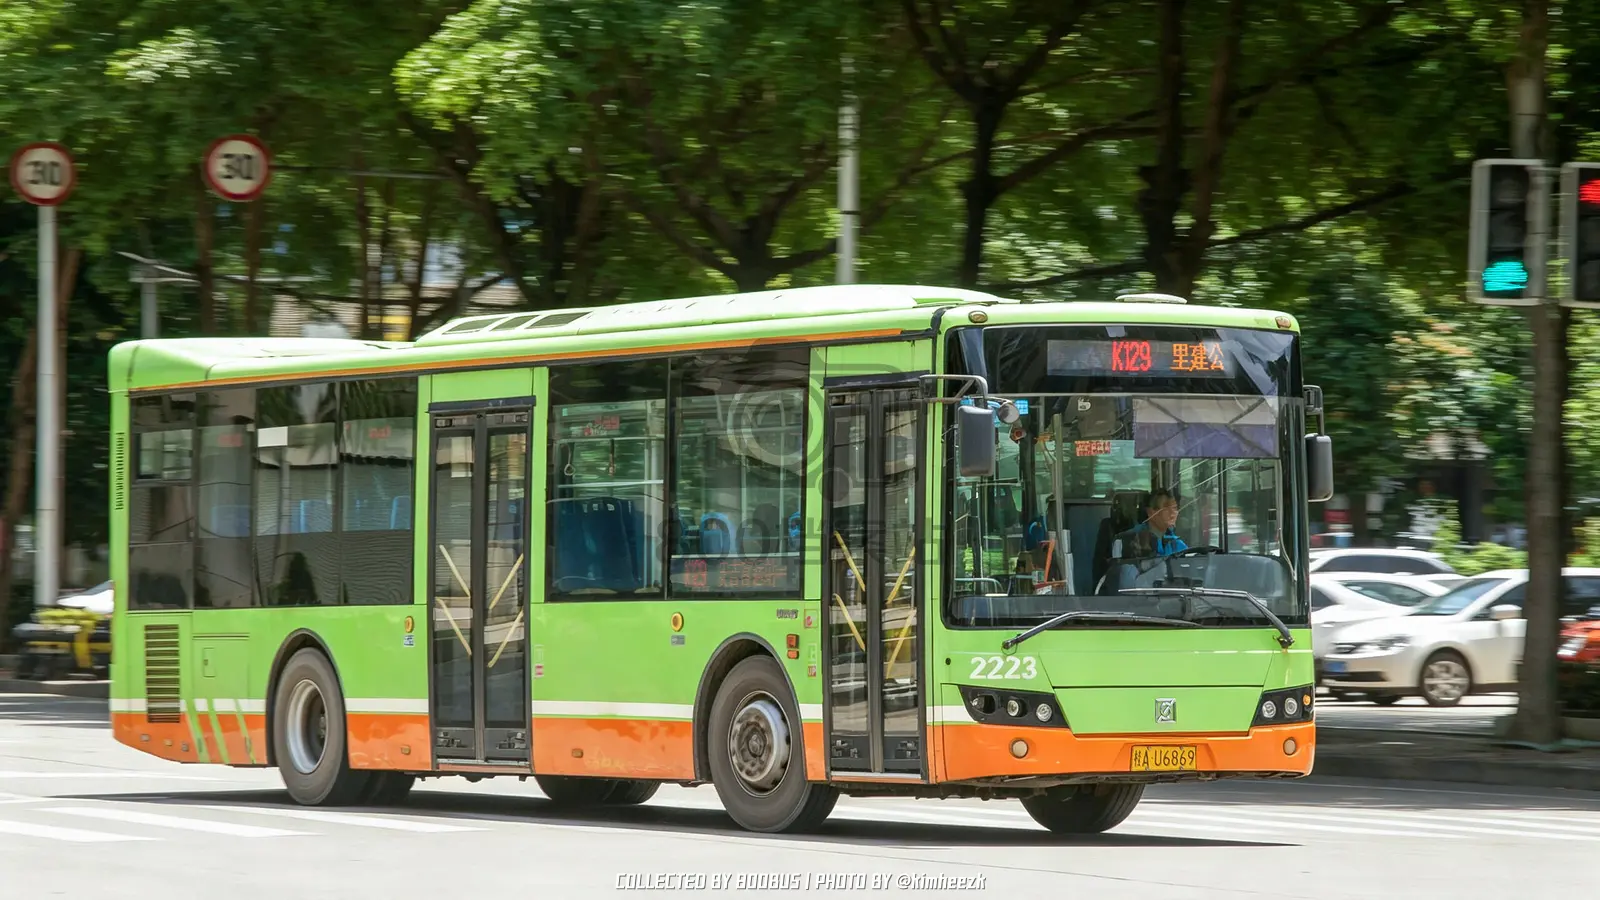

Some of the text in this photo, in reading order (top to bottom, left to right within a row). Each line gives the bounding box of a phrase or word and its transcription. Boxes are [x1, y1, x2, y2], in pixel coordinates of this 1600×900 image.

[217, 153, 253, 180] 30
[1112, 341, 1152, 372] K129
[1170, 340, 1224, 372] 里建公
[969, 656, 1037, 680] 2223
